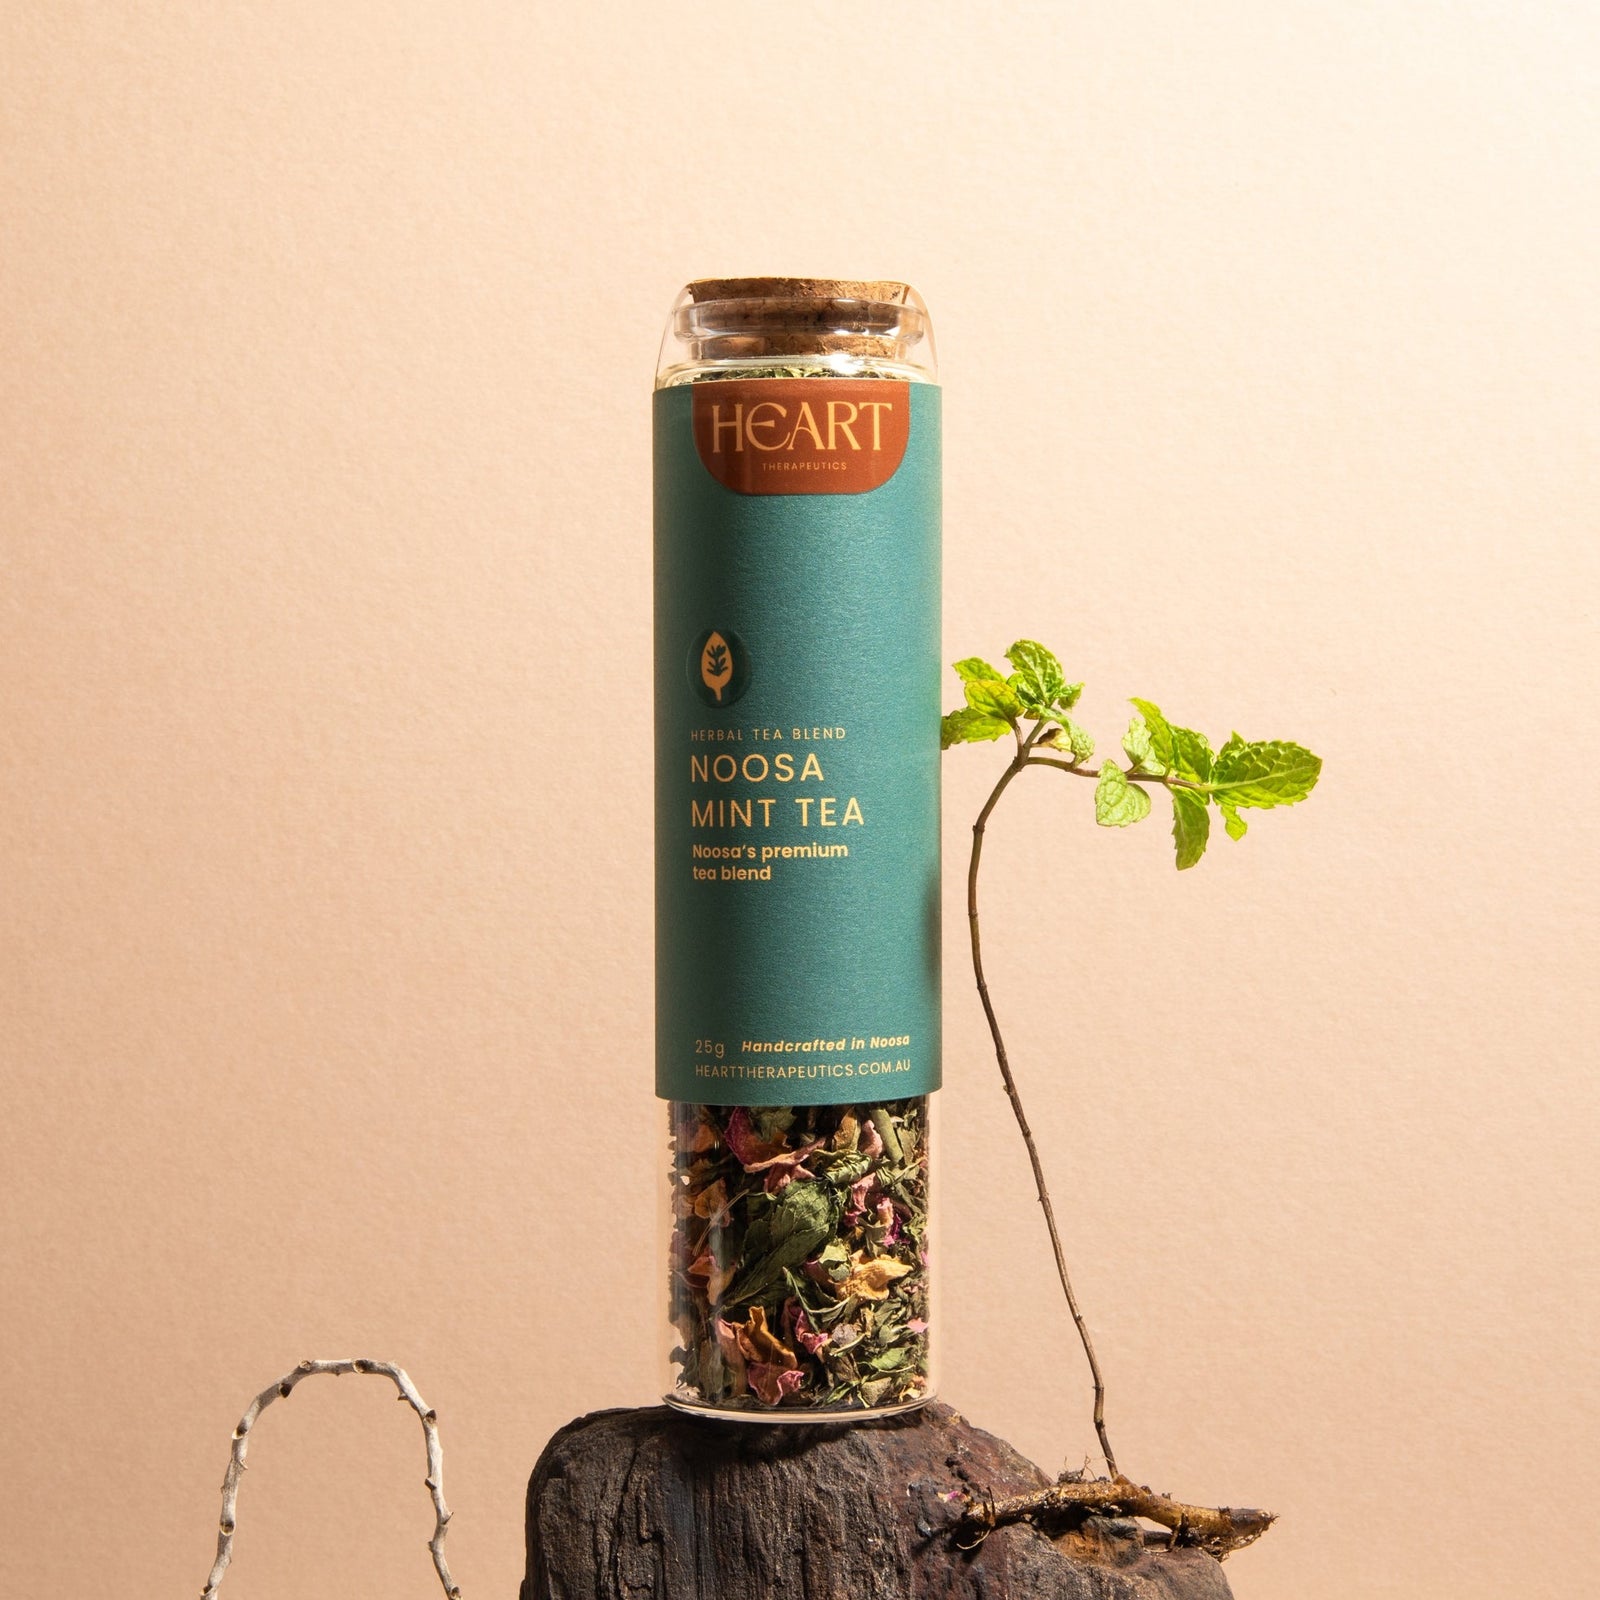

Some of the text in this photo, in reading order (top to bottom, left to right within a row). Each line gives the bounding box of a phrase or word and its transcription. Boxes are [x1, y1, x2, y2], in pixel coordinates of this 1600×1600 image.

[712, 401, 892, 453] HEART
[762, 462, 847, 471] THERAPEUTICS
[691, 728, 846, 741] HERBAL TEA BLEND
[691, 753, 824, 782] NOOSA
[691, 797, 864, 827] MINT TEA
[693, 842, 849, 863] Noosa's premium
[693, 865, 772, 880] tea blend
[695, 1035, 910, 1058] 25g Handcrafted in Noosa
[695, 1059, 911, 1078] HEARTTHERAPEUTICS.COM.AU
